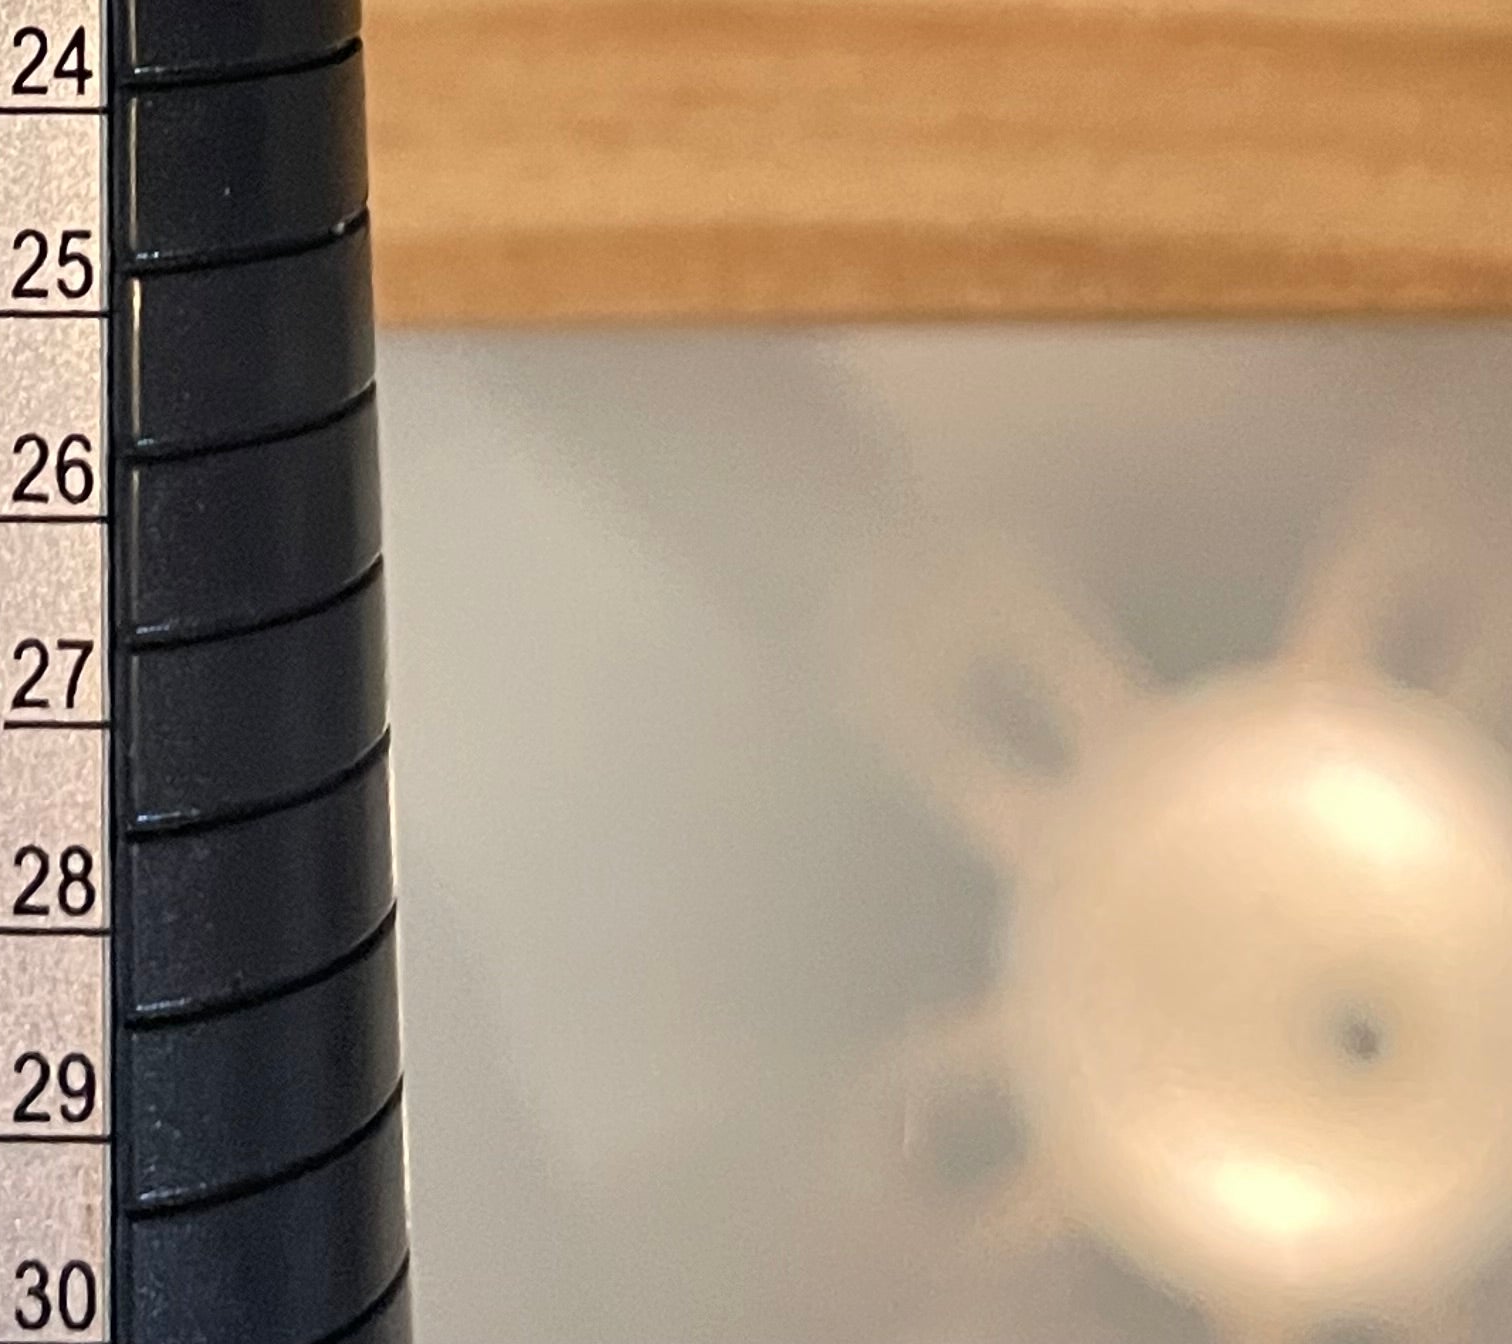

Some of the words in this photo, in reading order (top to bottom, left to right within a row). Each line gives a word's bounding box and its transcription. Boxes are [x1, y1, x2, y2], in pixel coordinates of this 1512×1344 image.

[10, 24, 93, 97] 24
[10, 227, 93, 301] 25
[10, 431, 97, 507] 26
[10, 636, 97, 711] 27
[10, 842, 97, 918] 28
[10, 1050, 97, 1125] 29
[10, 1258, 97, 1333] 30
